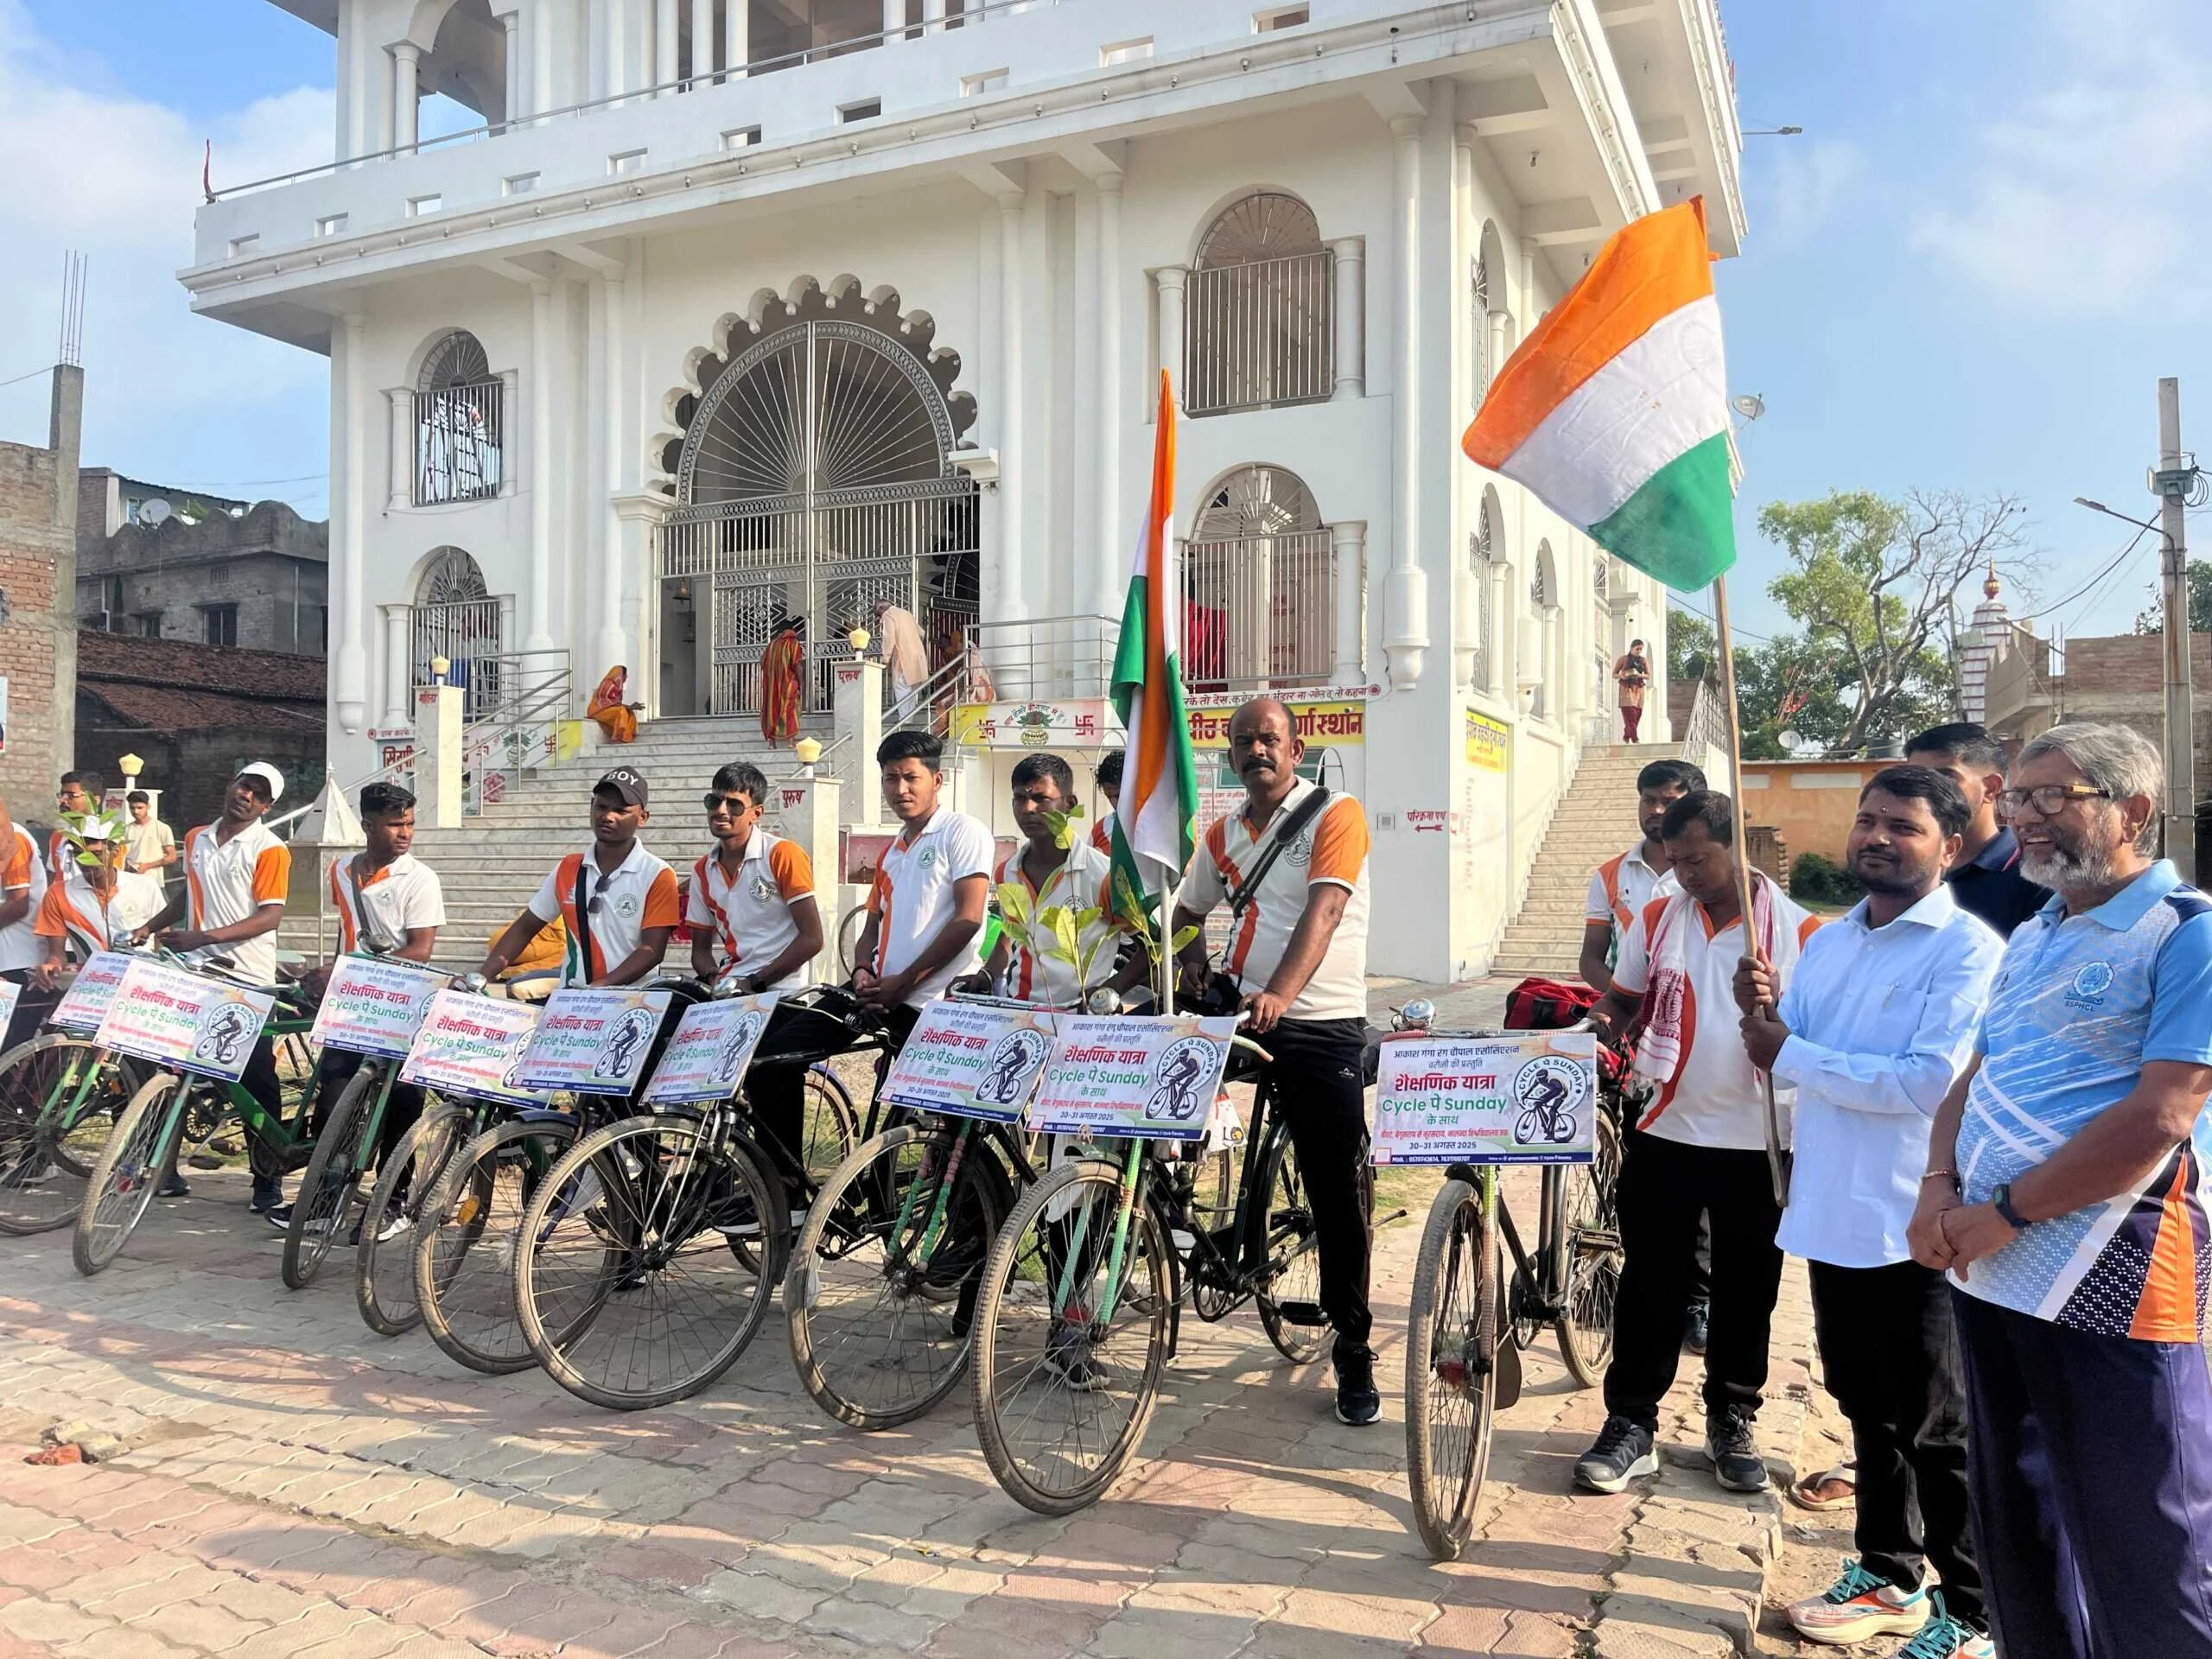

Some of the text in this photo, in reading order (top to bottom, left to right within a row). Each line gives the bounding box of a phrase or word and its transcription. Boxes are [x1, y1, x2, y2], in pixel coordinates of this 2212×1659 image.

[1182, 694, 1198, 707] रके
[1200, 694, 1211, 706] तो
[1334, 686, 1344, 697] तो
[1317, 712, 1363, 735] स्थान
[606, 771, 639, 785] BOY
[130, 985, 202, 1014] शैक्षणिक यात्रा
[340, 982, 411, 1006] शैक्षणिक यात्रा
[117, 1001, 147, 1016] Cycle
[159, 1012, 201, 1031] Sunday
[327, 997, 413, 1023] Cycle पे Sunday
[436, 1016, 508, 1042] शैक्षणिक यात्रा
[546, 1015, 605, 1032] शैक्षणिक यात्रा
[423, 1033, 508, 1063] Cycle पे Sunday
[532, 1033, 603, 1051] Cycle पे Sunday
[920, 1027, 988, 1051] शैक्षणिक यात्रा
[1475, 1045, 1520, 1056] एसोसिएशन
[905, 1047, 987, 1071] Cycle पे Sunday
[1065, 1045, 1147, 1065] शैक्षणिक यात्रा
[1162, 1042, 1184, 1066] CYCLE
[1196, 1040, 1215, 1068] SUNDAY
[1049, 1066, 1149, 1090] Cycle पे Sunday
[1395, 1072, 1497, 1092] शैक्षणिक यात्रा
[1519, 1063, 1540, 1090] CYCLE
[1554, 1059, 1583, 1087] SUNDAY
[1089, 1087, 1106, 1096] साथ
[1382, 1094, 1508, 1116] Cycle पे Sunday
[1427, 1115, 1459, 1126] के साथ
